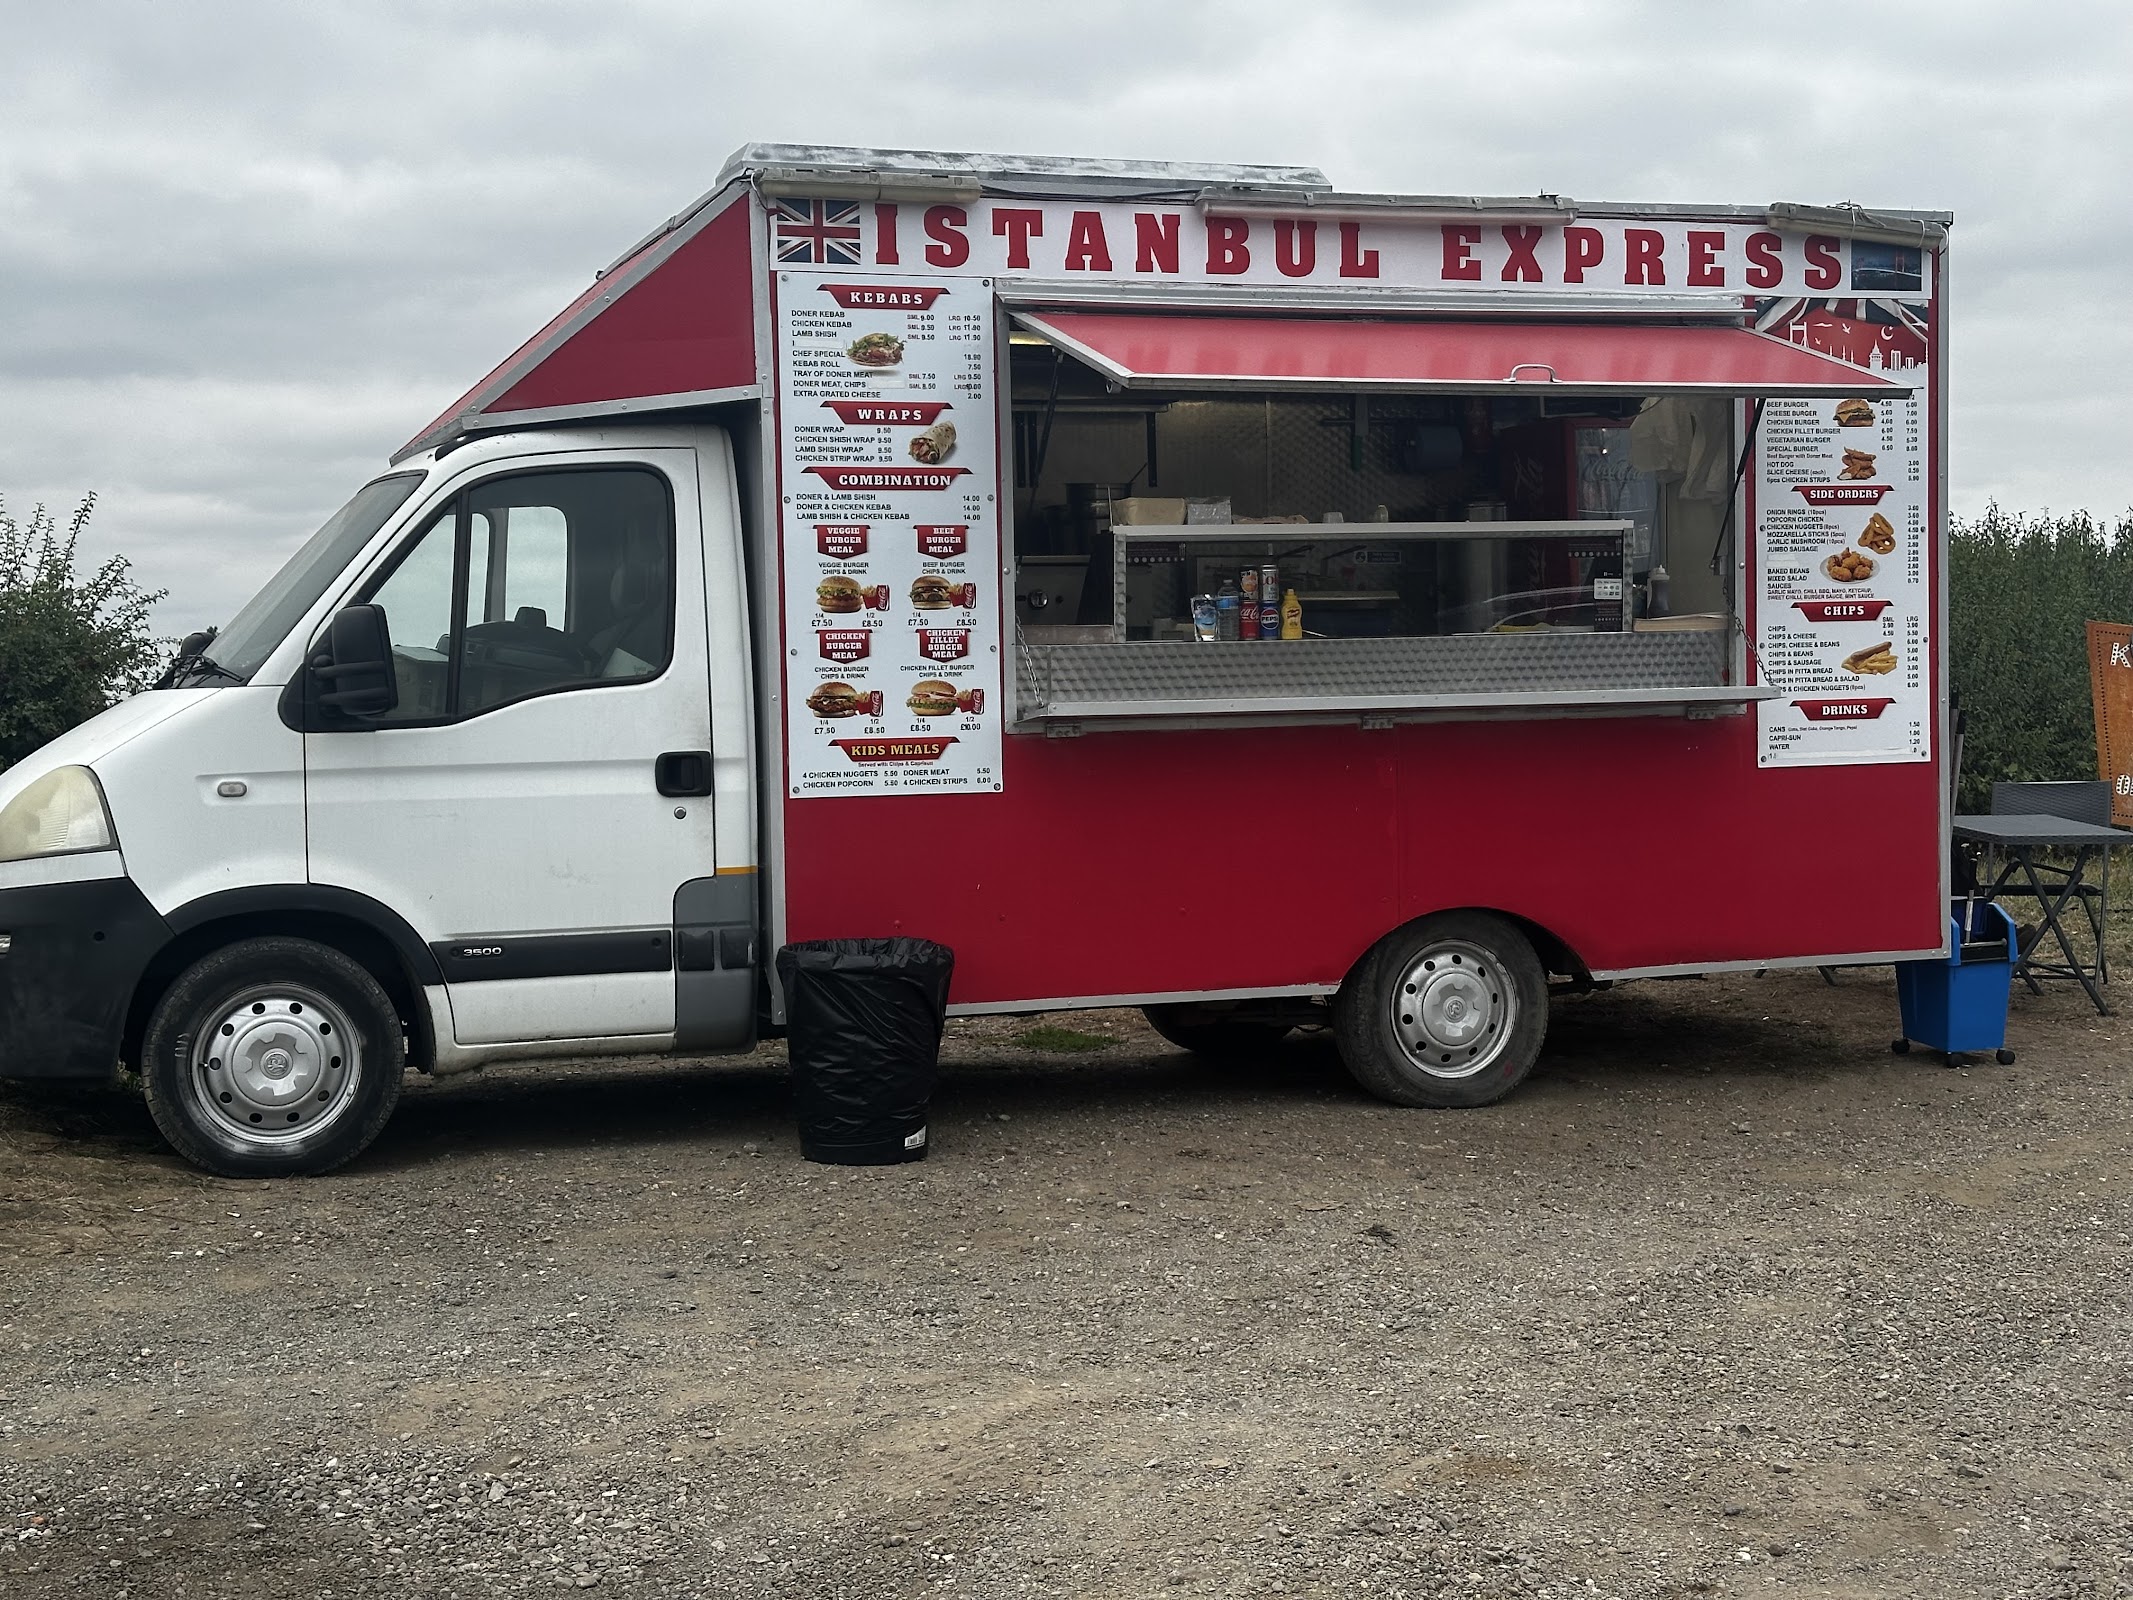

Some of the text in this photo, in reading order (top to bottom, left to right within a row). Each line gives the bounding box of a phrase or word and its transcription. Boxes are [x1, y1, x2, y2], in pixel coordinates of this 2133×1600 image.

[875, 203, 1842, 290] ISTANBUL EXPRESS
[850, 292, 923, 304] KEBABS
[858, 409, 922, 420] WRAPS
[839, 475, 950, 486] COMBINATION
[1810, 489, 1878, 498] SIDE ORDERS
[826, 536, 861, 544] BURGER
[1824, 606, 1864, 615] CHIPS
[812, 619, 832, 627] £7.50
[1823, 705, 1867, 715] DRINKS
[851, 744, 940, 756] KIDS MEALS
[464, 947, 502, 956] 3500
